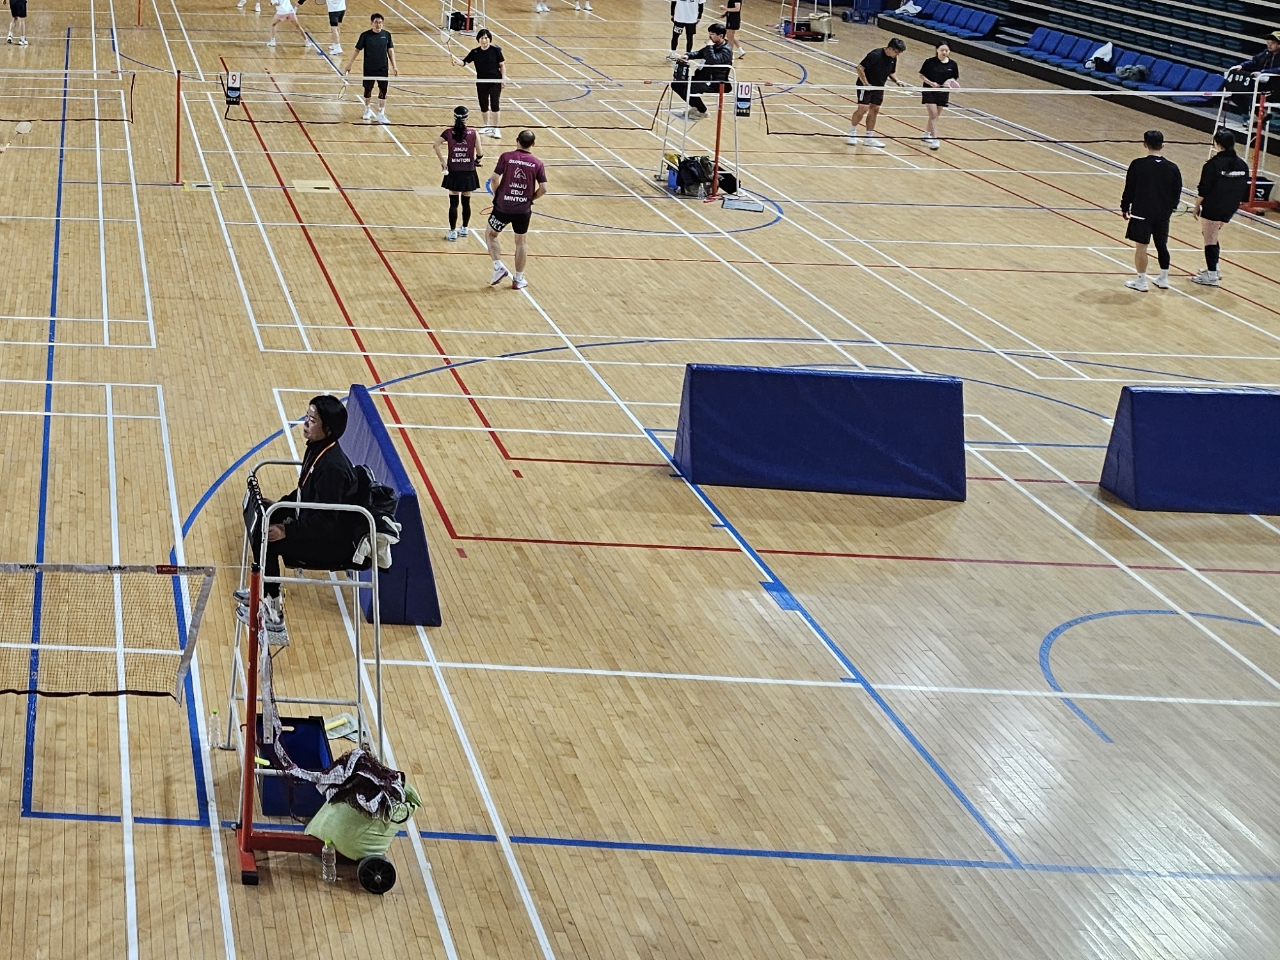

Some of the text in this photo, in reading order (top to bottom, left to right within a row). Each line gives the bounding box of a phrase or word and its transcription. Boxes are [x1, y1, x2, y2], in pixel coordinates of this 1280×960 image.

[231, 73, 237, 85] 9
[1244, 76, 1251, 86] 3
[739, 84, 750, 96] 10
[509, 182, 527, 190] JINJU
[504, 195, 528, 203] MINTON
